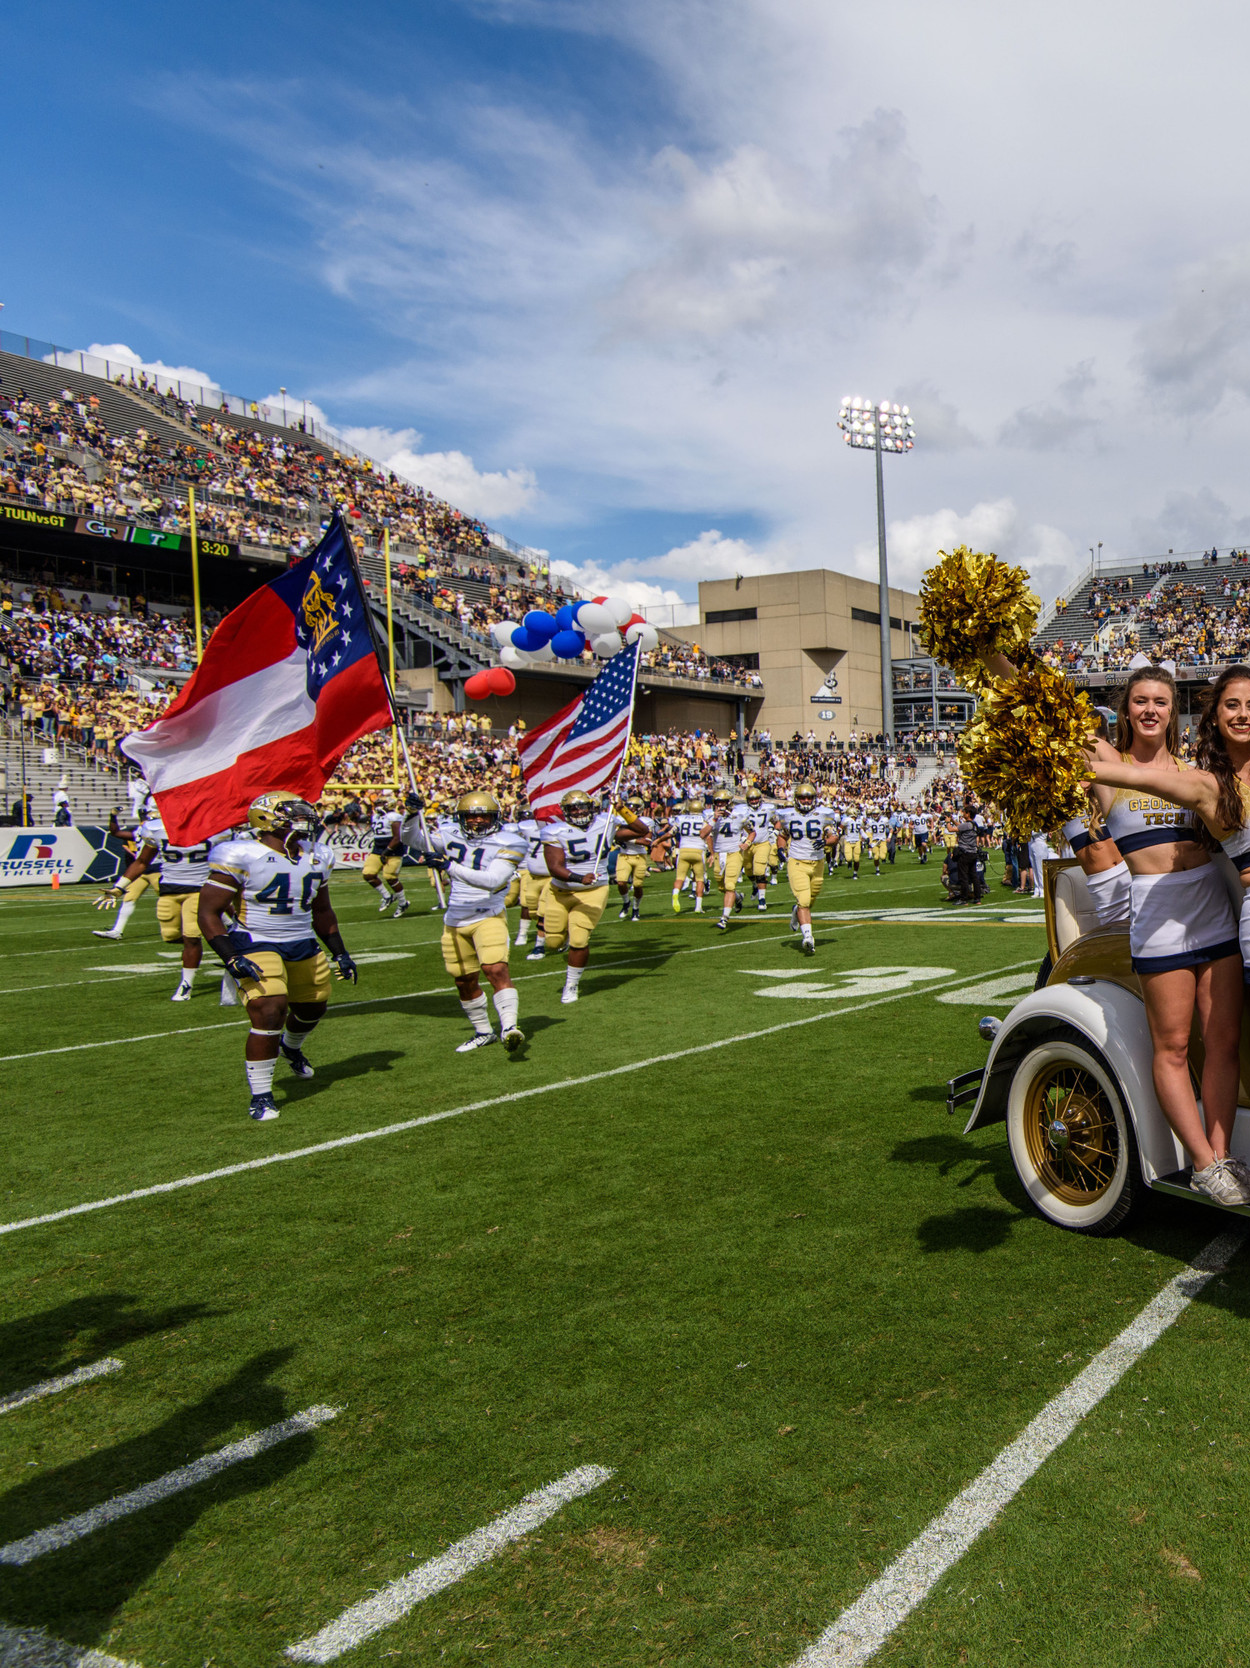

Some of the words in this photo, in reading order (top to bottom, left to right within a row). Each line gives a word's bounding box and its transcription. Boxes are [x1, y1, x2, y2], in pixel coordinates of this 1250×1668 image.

[202, 541, 229, 557] 3:20
[1106, 678, 1129, 686] GUYO
[821, 711, 833, 719] 19
[1143, 812, 1185, 826] TECH
[681, 821, 703, 837] 85
[720, 822, 733, 838] 4
[790, 819, 822, 840] 66
[343, 851, 371, 862] zer
[446, 841, 486, 870] 21
[0, 859, 74, 870] RUSSELL
[3, 868, 73, 876] THLETIC
